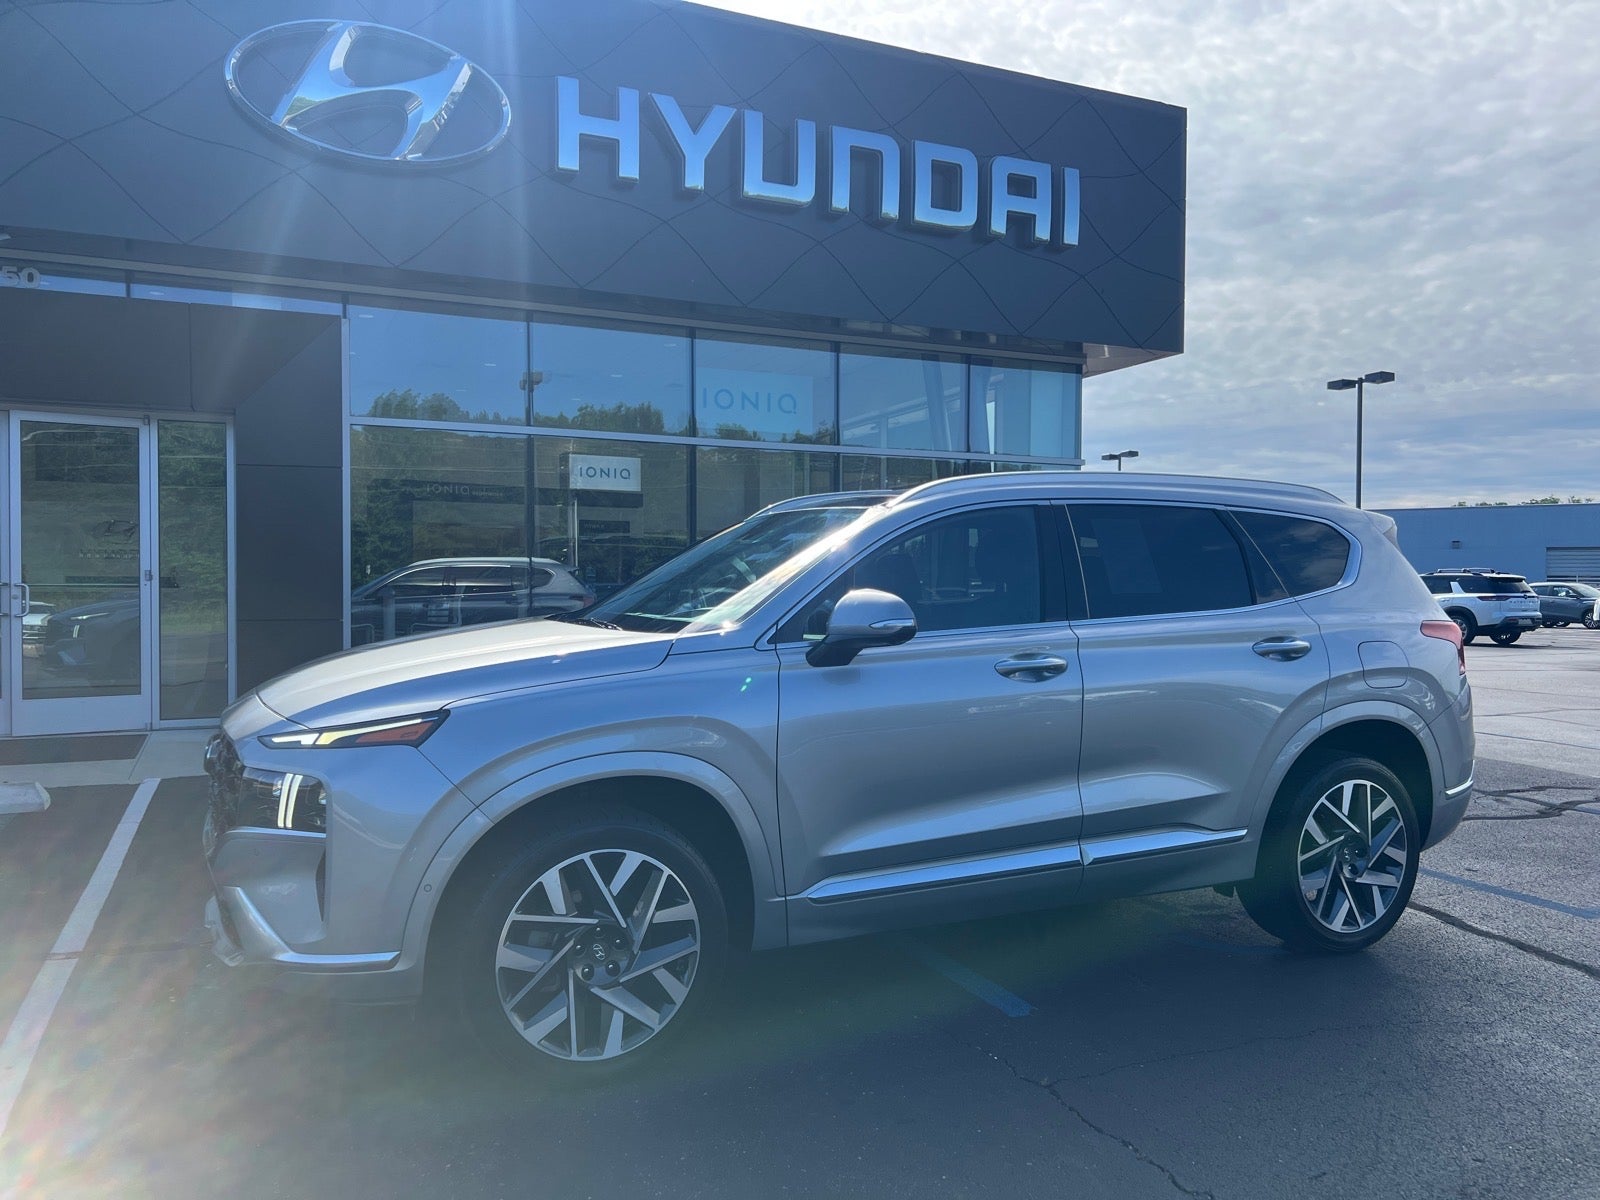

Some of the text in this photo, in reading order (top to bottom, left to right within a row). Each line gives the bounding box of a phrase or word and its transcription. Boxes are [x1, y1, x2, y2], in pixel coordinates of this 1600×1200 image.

[555, 75, 1081, 248] HYUNDAI
[702, 387, 797, 415] IONIQ
[579, 466, 631, 480] IONIQ
[426, 483, 470, 497] IONIQ
